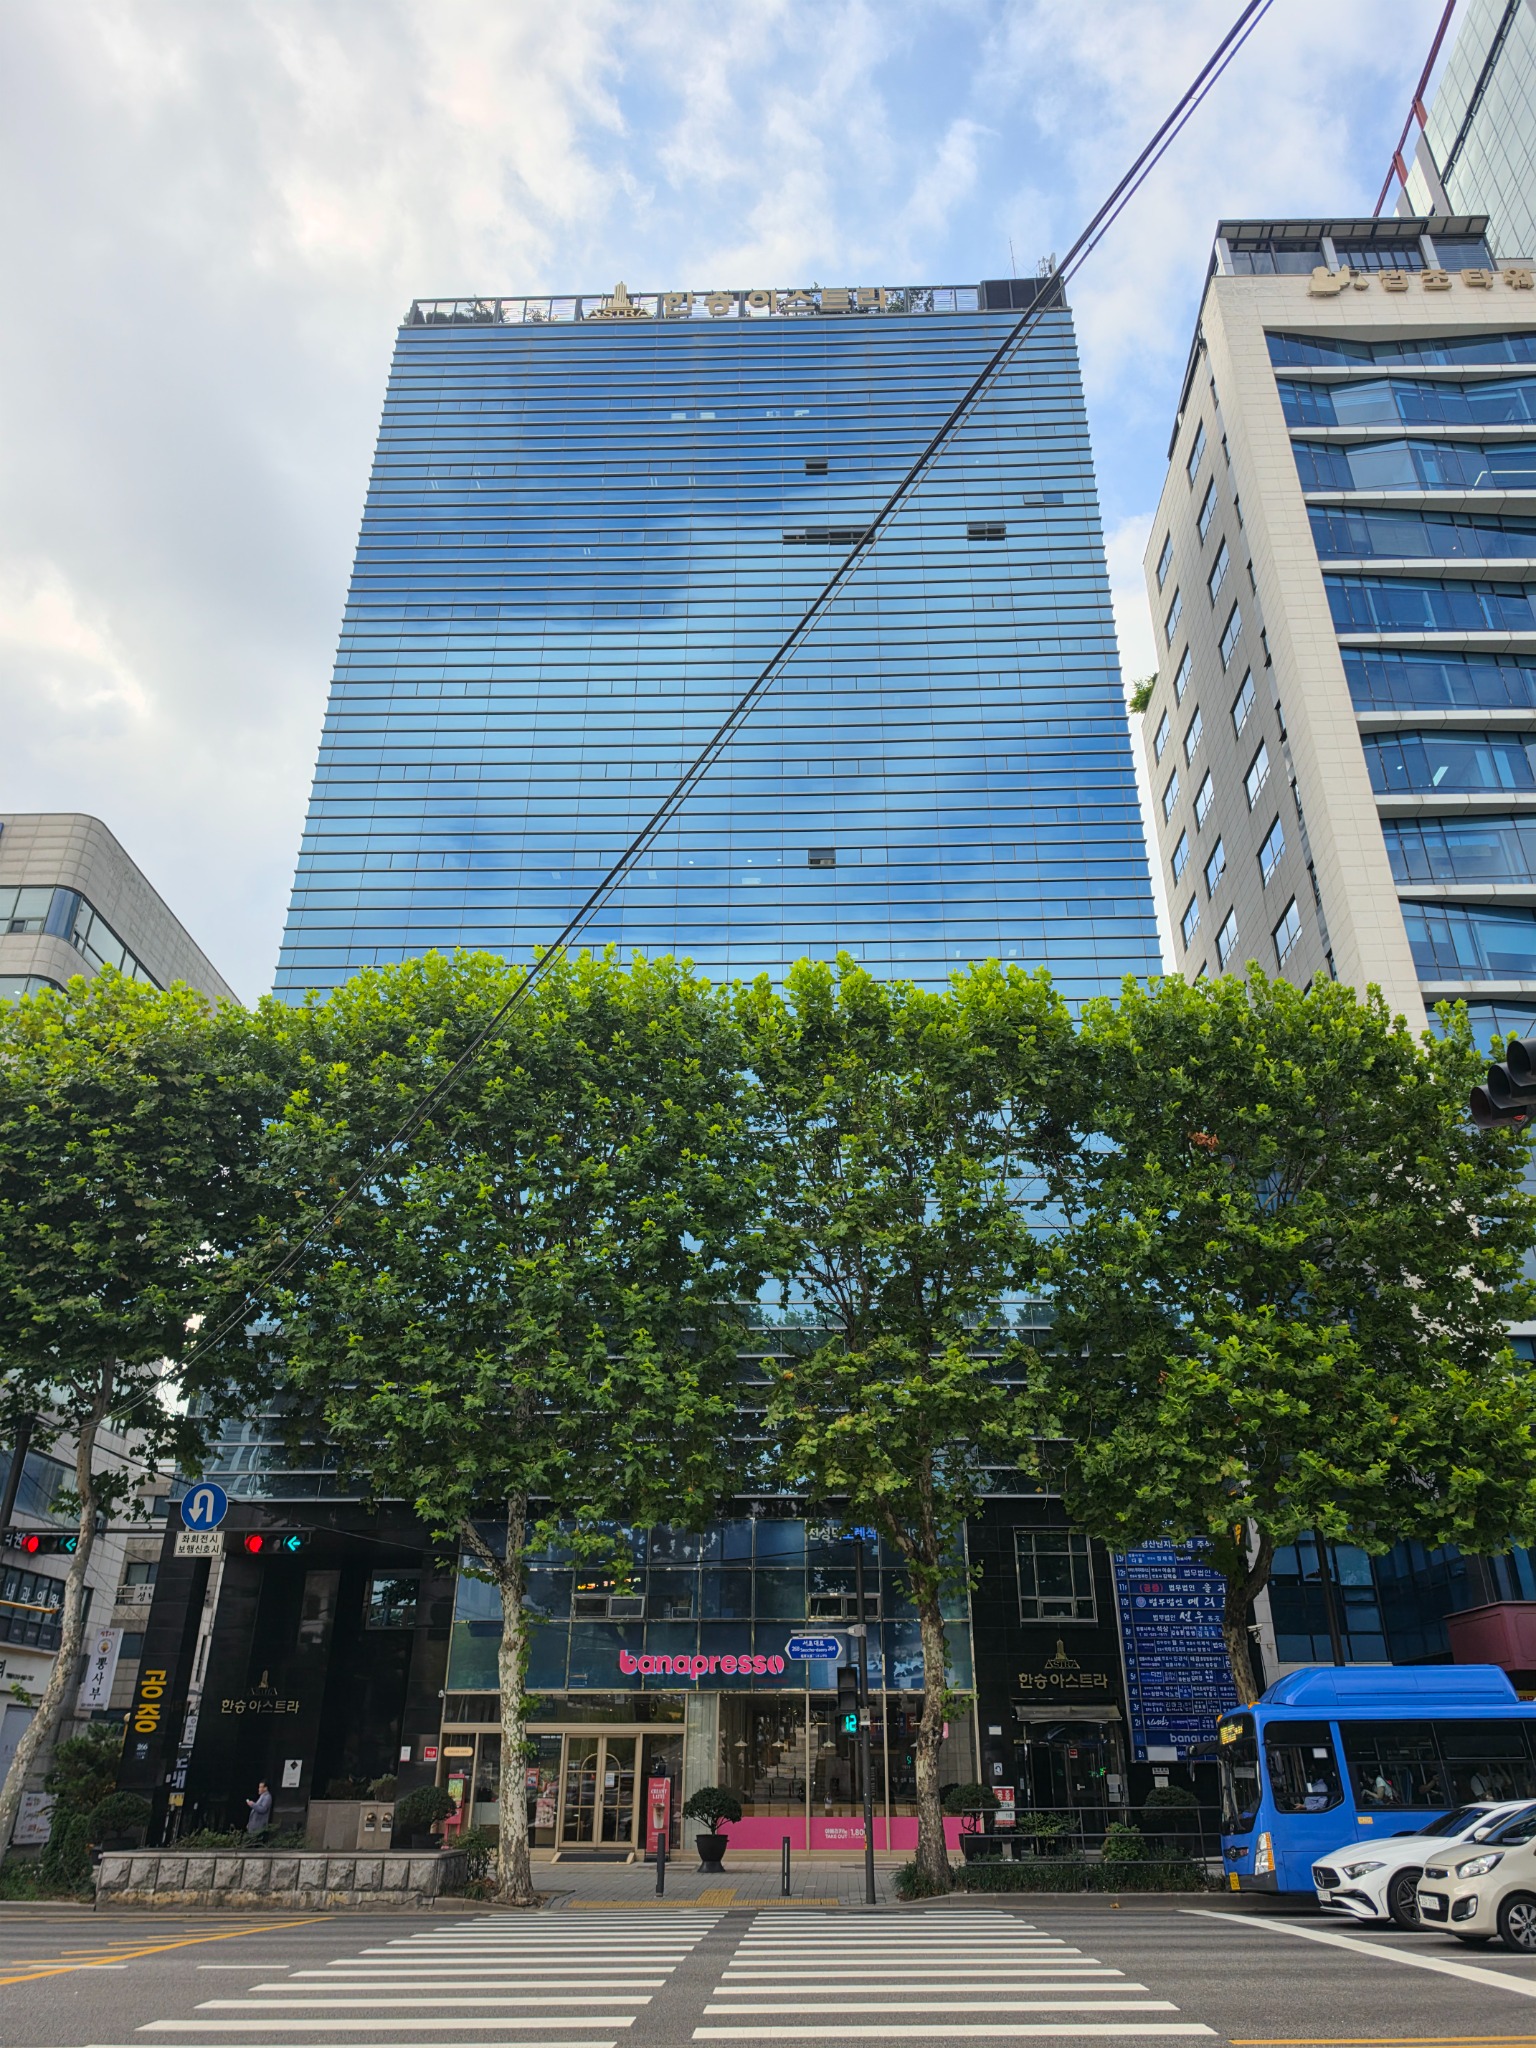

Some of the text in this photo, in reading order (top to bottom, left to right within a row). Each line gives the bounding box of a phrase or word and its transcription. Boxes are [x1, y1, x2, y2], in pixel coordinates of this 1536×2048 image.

[588, 308, 652, 318] ASTRA
[182, 1534, 218, 1543] 좌회전시
[177, 1544, 219, 1553] 보행신호시
[1184, 1569, 1211, 1577] 법무법인
[1168, 1584, 1195, 1592] 법무법인
[1148, 1598, 1183, 1607] 법무법인
[619, 1649, 785, 1680] banapresso
[134, 1669, 167, 1733] 공증
[845, 1714, 857, 1732] 12
